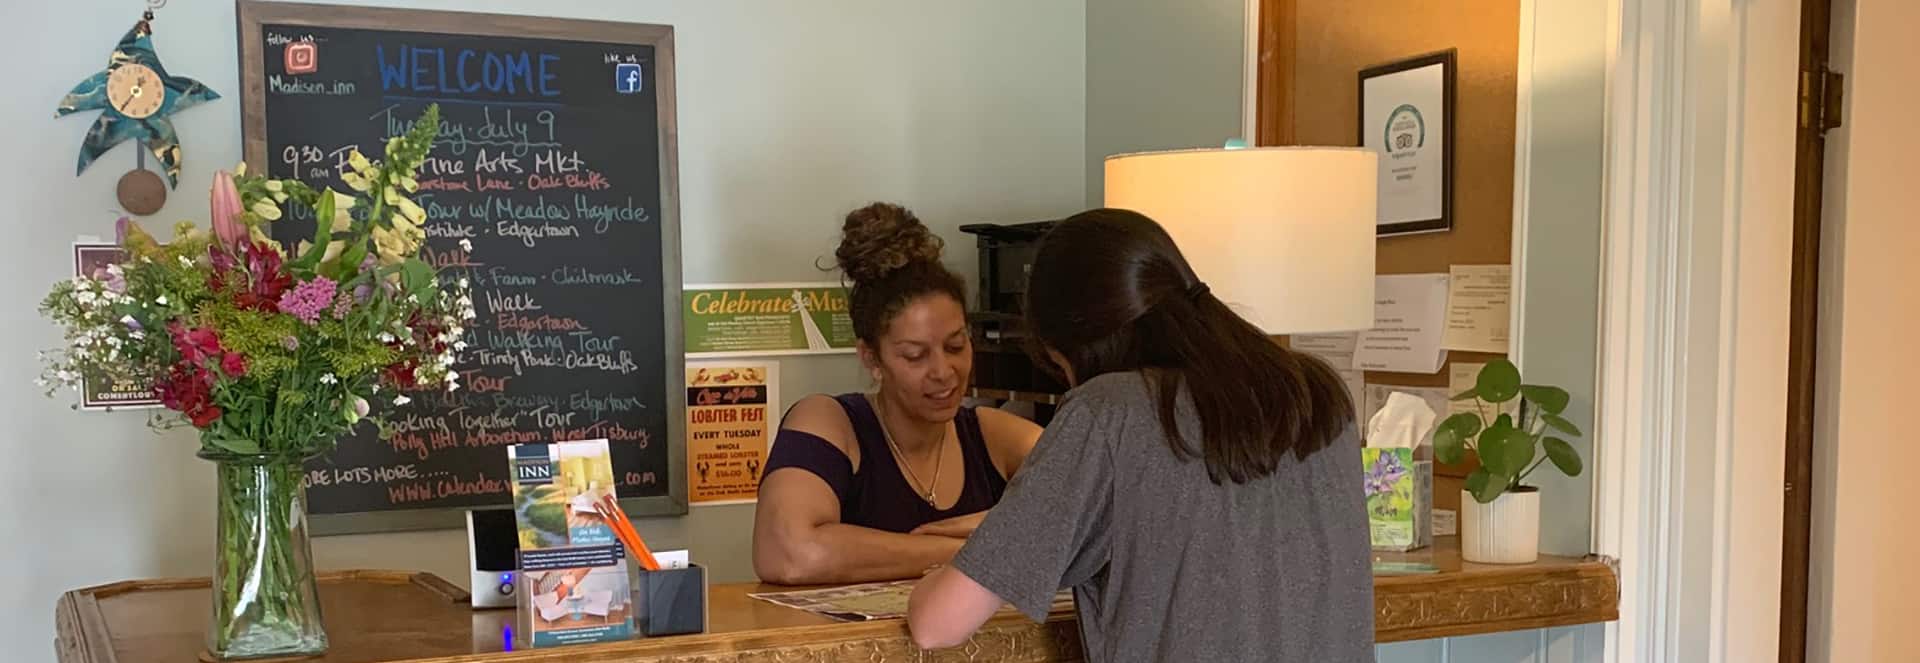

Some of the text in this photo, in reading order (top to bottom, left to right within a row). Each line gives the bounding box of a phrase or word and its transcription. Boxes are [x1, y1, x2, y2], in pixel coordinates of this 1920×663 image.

[376, 43, 561, 97] WELCOME
[370, 104, 555, 157] Tueay July 9
[475, 149, 523, 174] Arts
[476, 174, 515, 192] Lane
[528, 175, 564, 189] Oak
[565, 172, 611, 191] Bluffs
[496, 197, 570, 220] Meadow
[424, 220, 580, 248] nstitute Edgartown
[488, 267, 536, 285] Farm
[552, 265, 641, 284] Chilmark
[486, 289, 542, 314] Walk
[691, 290, 792, 315] Celebrate
[498, 314, 588, 336] Edgartown
[487, 330, 564, 355] Walking
[568, 331, 621, 352] Tour
[523, 350, 557, 368] Park
[596, 351, 639, 372] Bluffs
[460, 368, 513, 392] Tour
[569, 390, 647, 423] Edgartown
[691, 407, 764, 424] LOBSTER FEST
[390, 410, 449, 433] ooking
[529, 405, 577, 428] Tour
[391, 434, 429, 459] Polly
[431, 432, 458, 450] Hill
[586, 422, 650, 449] Tisbury
[693, 430, 761, 440] EVERY TUESDAY
[303, 468, 331, 488] ORE
[335, 468, 371, 484] LOTS
[519, 465, 550, 478] INN
